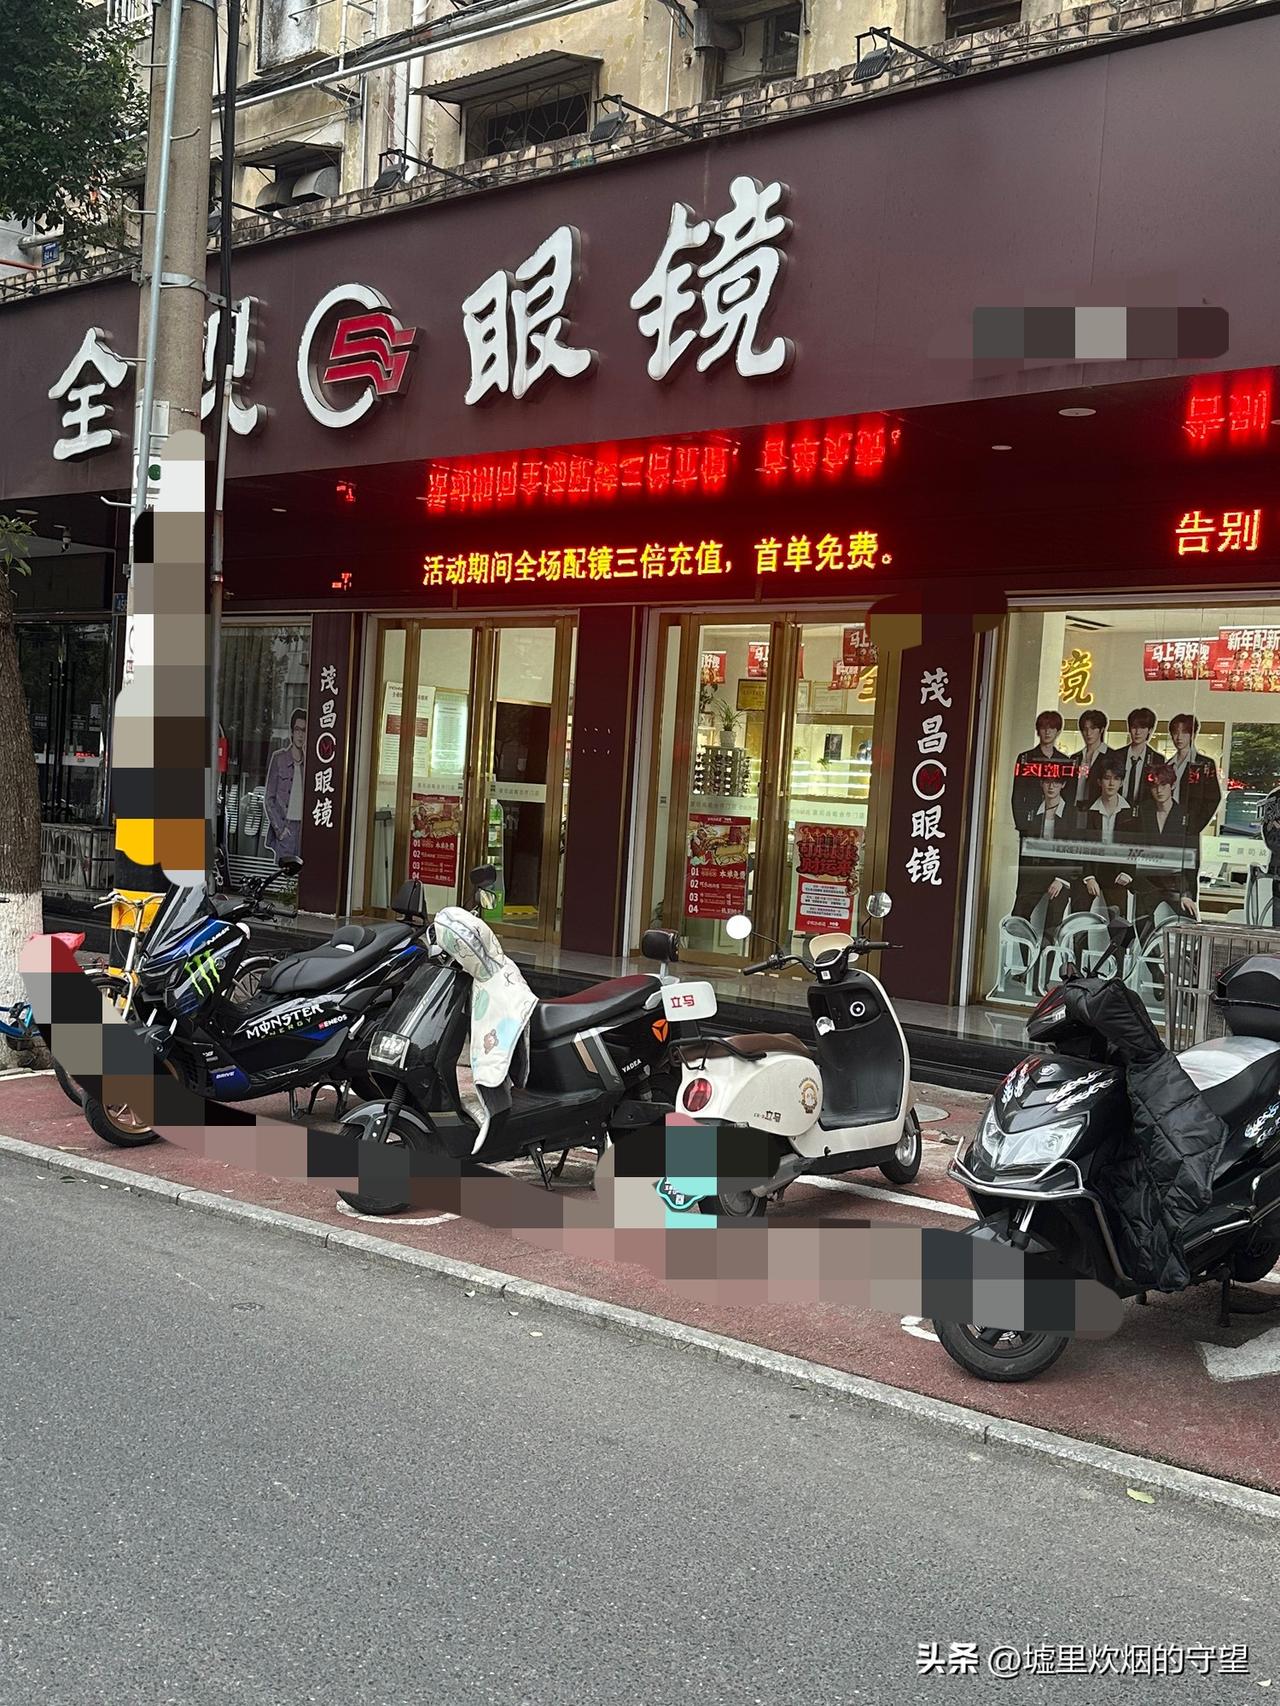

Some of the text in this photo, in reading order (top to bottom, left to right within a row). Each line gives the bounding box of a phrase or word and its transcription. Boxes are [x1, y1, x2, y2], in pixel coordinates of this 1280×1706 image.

[462, 176, 787, 406] 眼镜
[1175, 509, 1261, 555] 告别
[905, 667, 952, 886] 茂昌 眼镜
[312, 767, 336, 828] 眼镜
[690, 867, 699, 876] 01
[690, 879, 699, 888] 02
[689, 892, 699, 902] 03
[688, 904, 699, 913] 04
[670, 995, 695, 1009] 立马
[323, 1014, 348, 1028] ENEOS
[621, 1058, 642, 1073] YADEA
